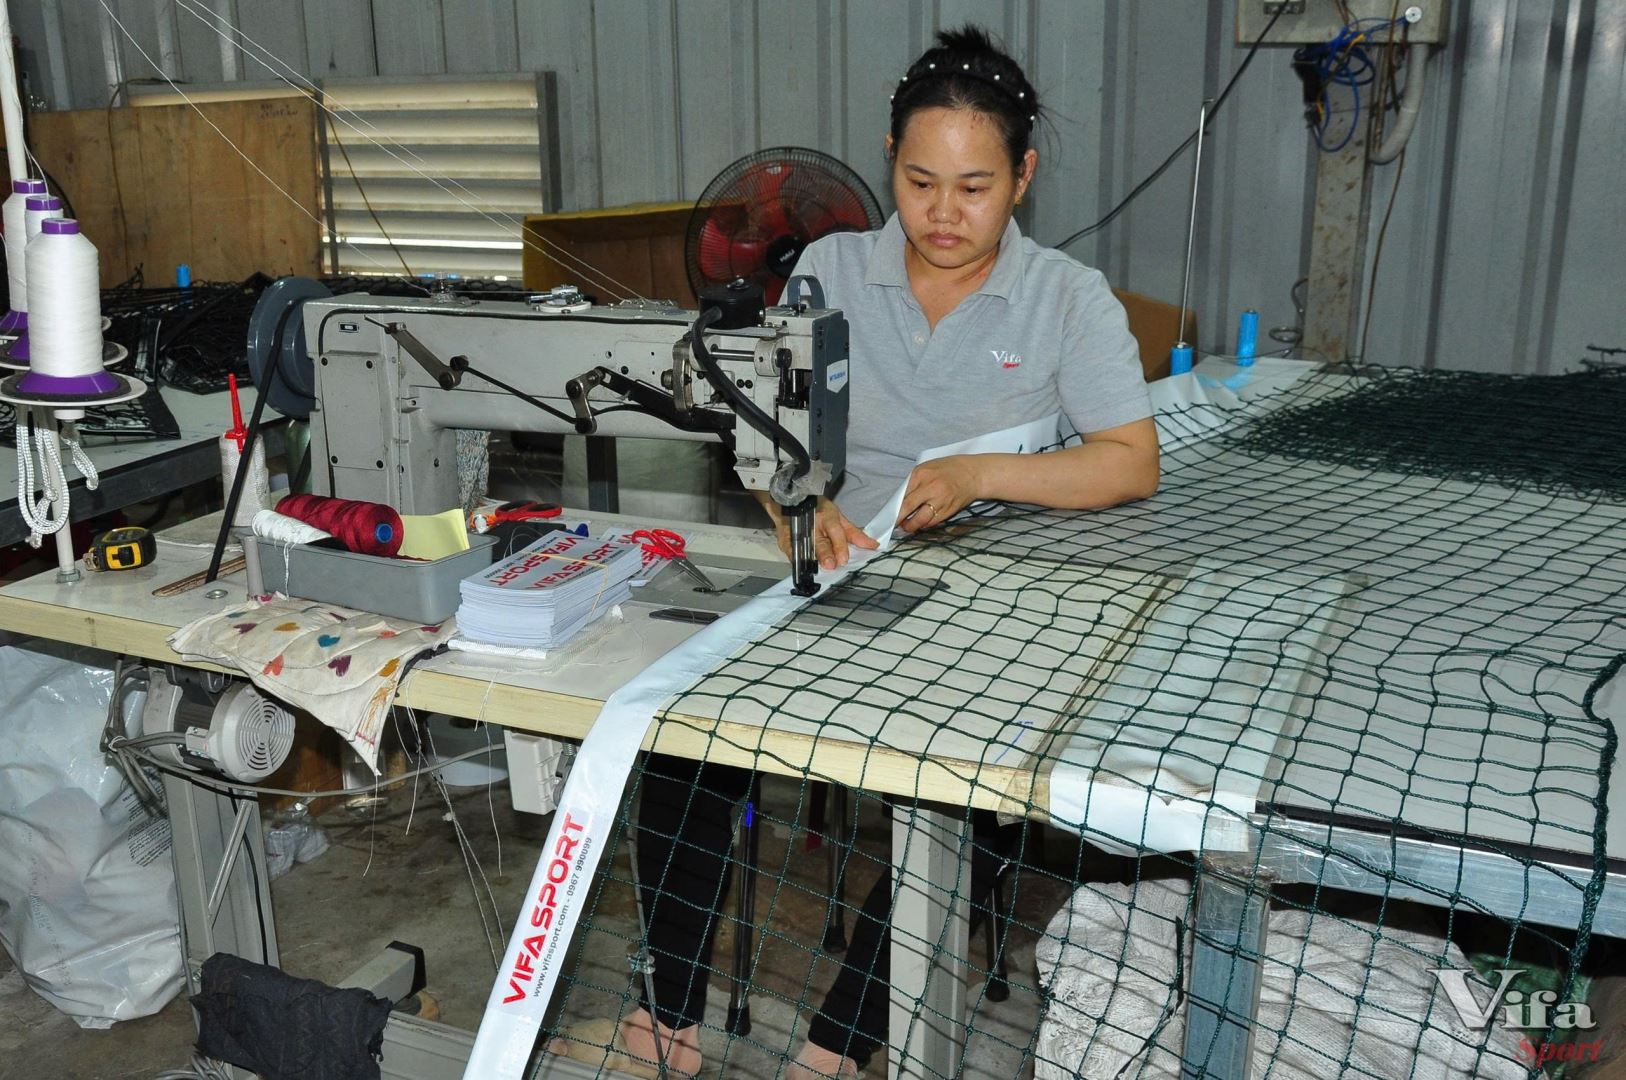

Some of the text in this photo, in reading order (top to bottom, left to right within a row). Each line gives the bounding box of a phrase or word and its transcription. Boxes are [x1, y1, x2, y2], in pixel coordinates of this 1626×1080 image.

[990, 350, 1022, 363] Vifa
[533, 905, 569, 997] www.vifasport.com
[568, 873, 580, 897] 0967
[576, 837, 592, 871] 990099
